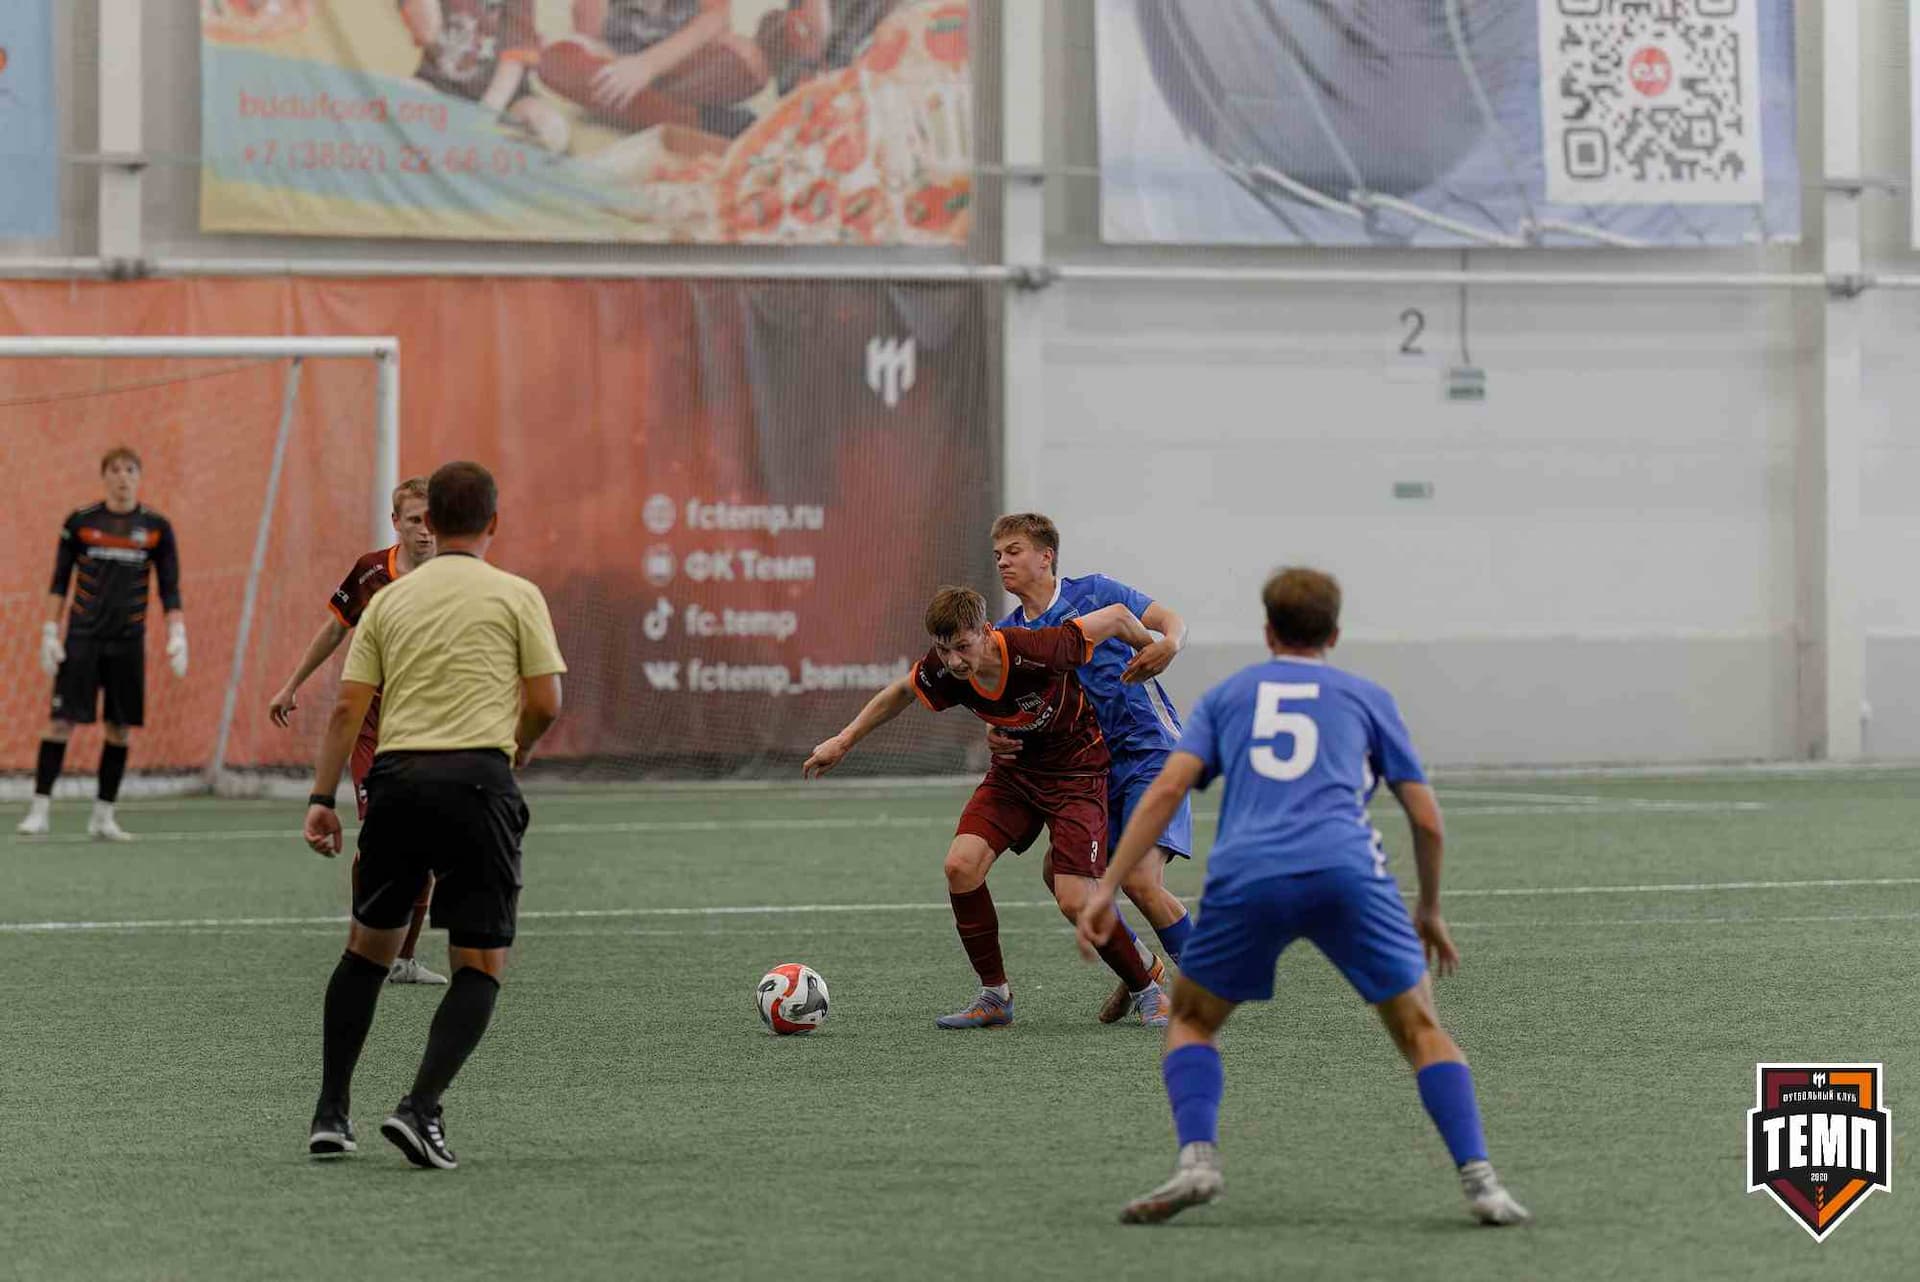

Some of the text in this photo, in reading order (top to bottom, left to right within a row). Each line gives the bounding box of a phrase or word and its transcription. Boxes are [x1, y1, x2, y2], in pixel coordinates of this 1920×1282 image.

[245, 139, 278, 166] +7
[1399, 307, 1425, 356] 2
[685, 497, 824, 535] fctemp.ru
[684, 549, 815, 581] ФК Темп
[685, 603, 797, 641] fc.temp
[1250, 681, 1320, 781] 5
[1090, 840, 1099, 863] 3
